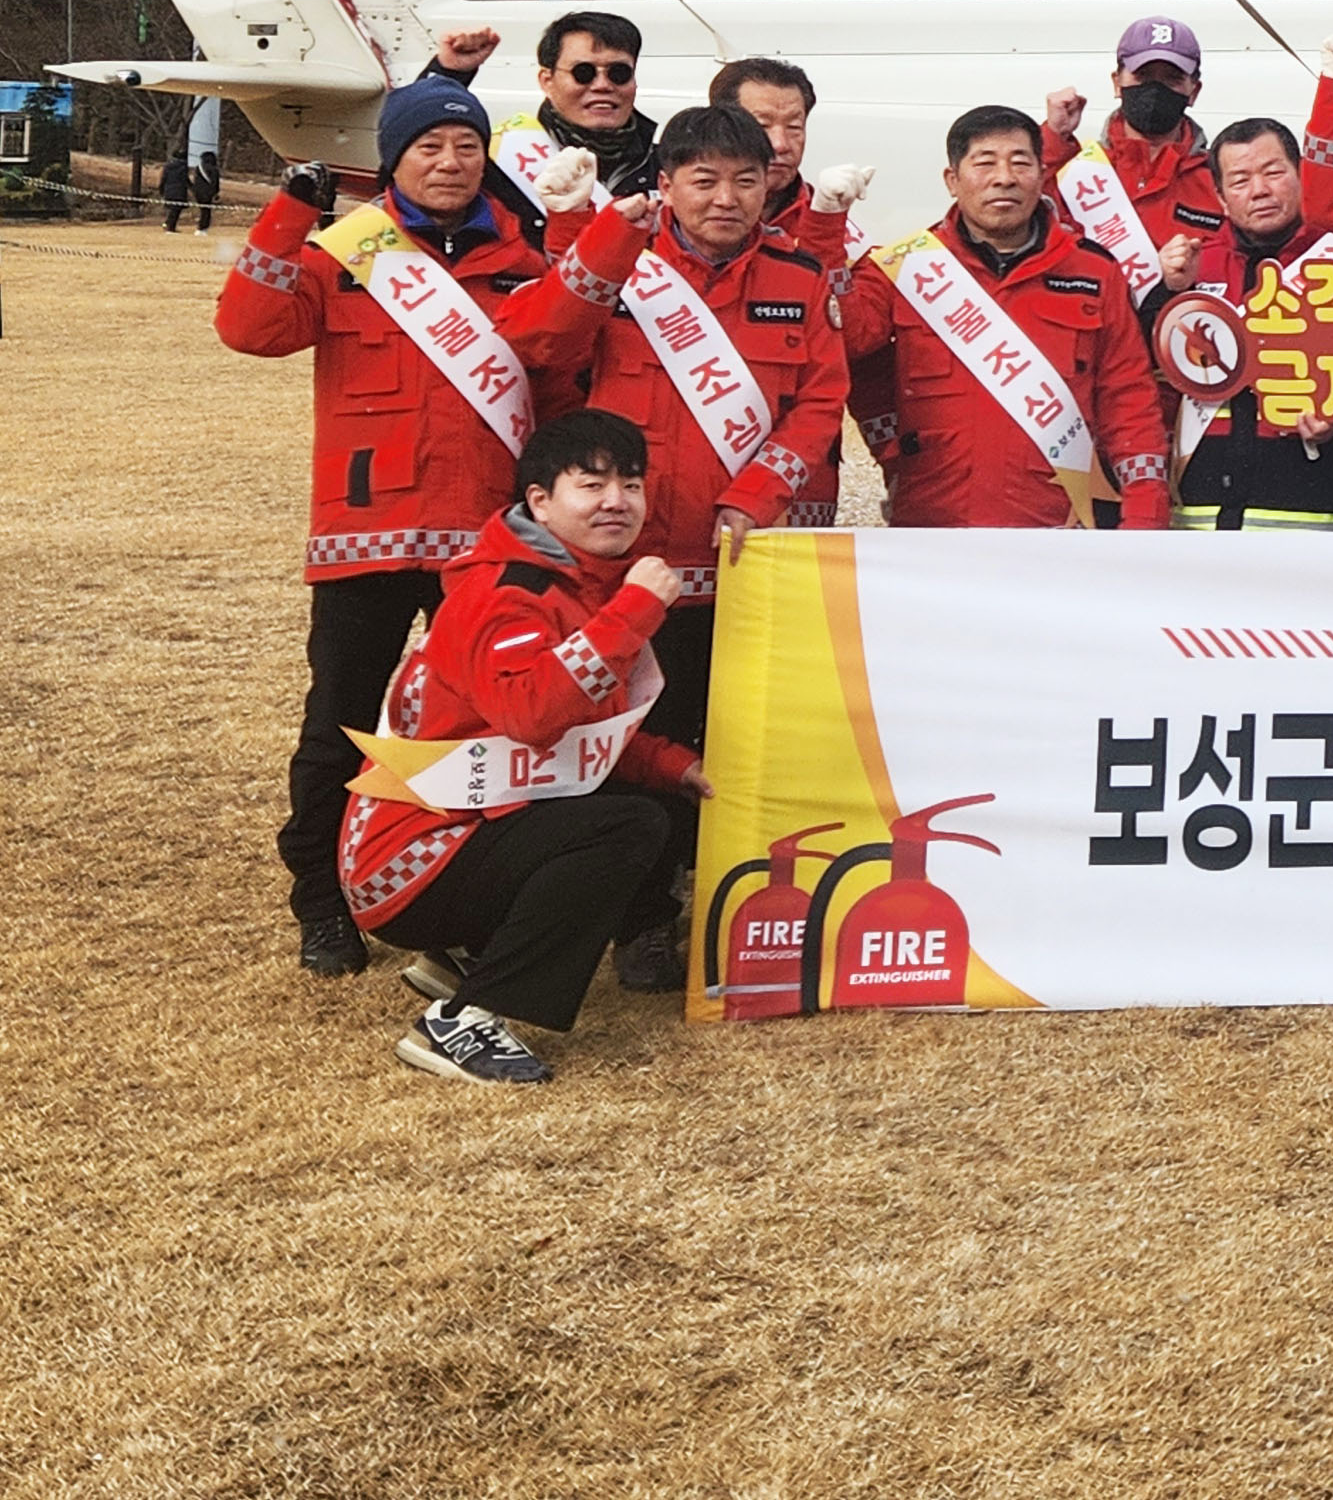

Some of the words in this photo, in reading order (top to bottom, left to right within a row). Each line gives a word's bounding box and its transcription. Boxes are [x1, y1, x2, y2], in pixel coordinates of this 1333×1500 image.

[1074, 175, 1158, 290] 산불조
[629, 259, 761, 454] 산불조심
[913, 261, 1065, 429] 산불조심
[747, 920, 807, 947] FIRE
[861, 930, 946, 967] FIRE
[849, 969, 952, 985] EXTINGUISHER
[443, 1031, 485, 1065] N
